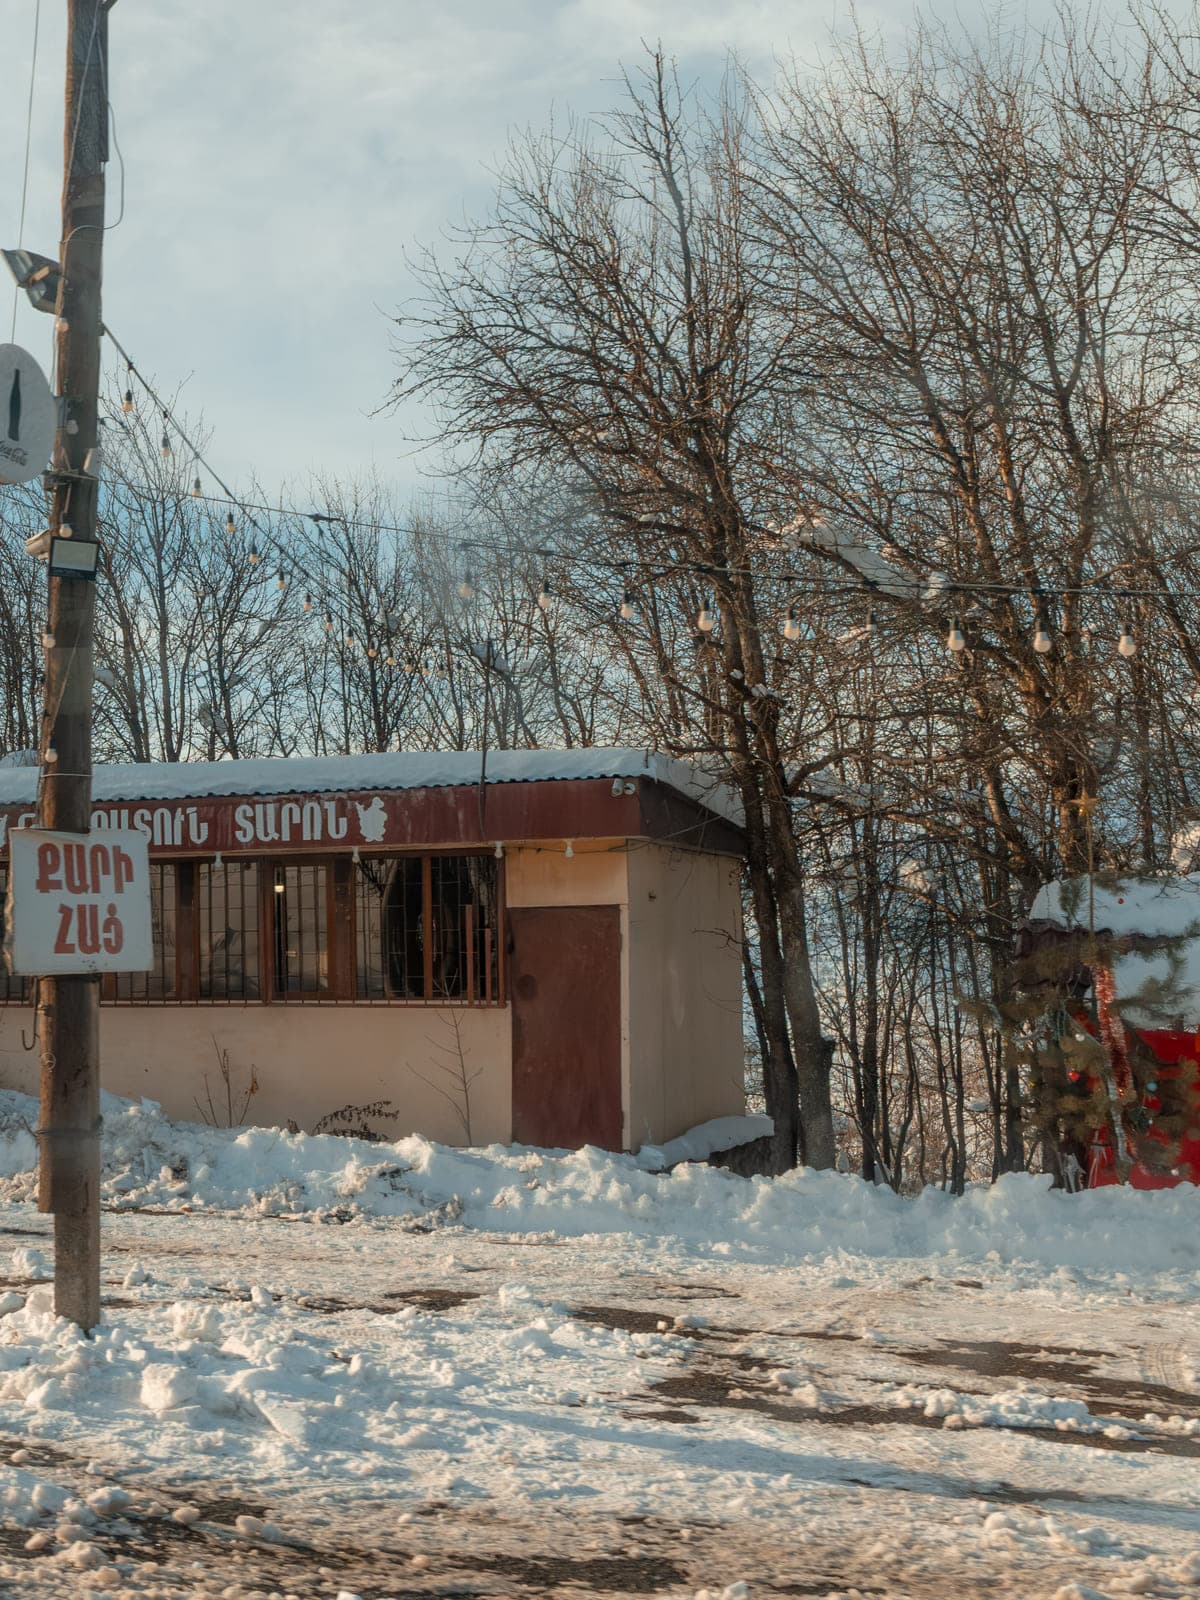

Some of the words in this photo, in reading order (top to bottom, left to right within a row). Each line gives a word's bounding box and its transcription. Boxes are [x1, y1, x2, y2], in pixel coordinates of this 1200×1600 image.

[234, 801, 348, 843] ՏԱՐՈՆ
[35, 842, 135, 894] ՔԱՐԻ
[53, 902, 124, 955] ՀԱՑ
